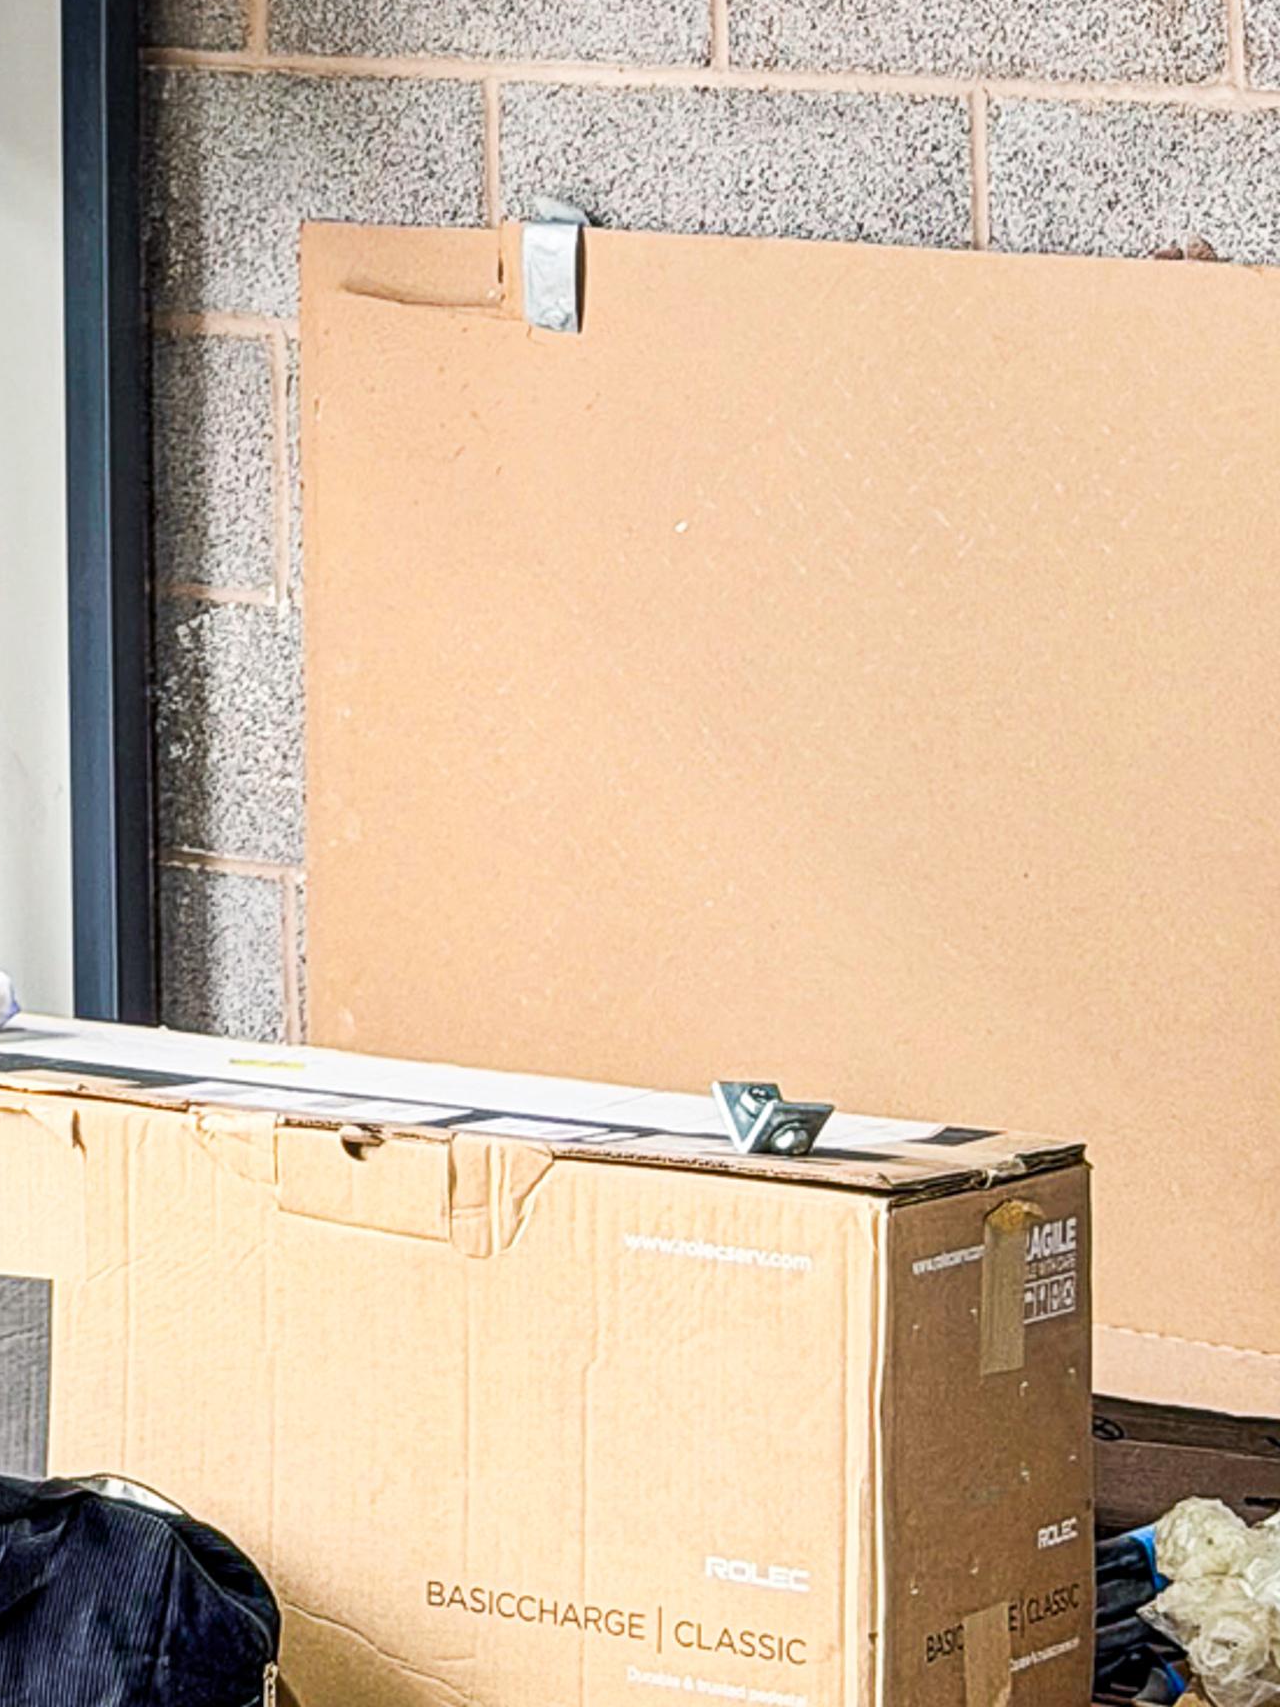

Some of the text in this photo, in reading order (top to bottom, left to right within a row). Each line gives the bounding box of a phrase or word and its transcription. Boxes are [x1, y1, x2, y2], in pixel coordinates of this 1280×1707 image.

[1026, 1217, 1077, 1262] AGILE
[1038, 1516, 1079, 1550] ROLEC
[705, 1556, 811, 1592] ROLEC
[426, 1581, 807, 1665] BASICCHARGE CLASSIC
[1026, 1583, 1080, 1624] CLASSIC
